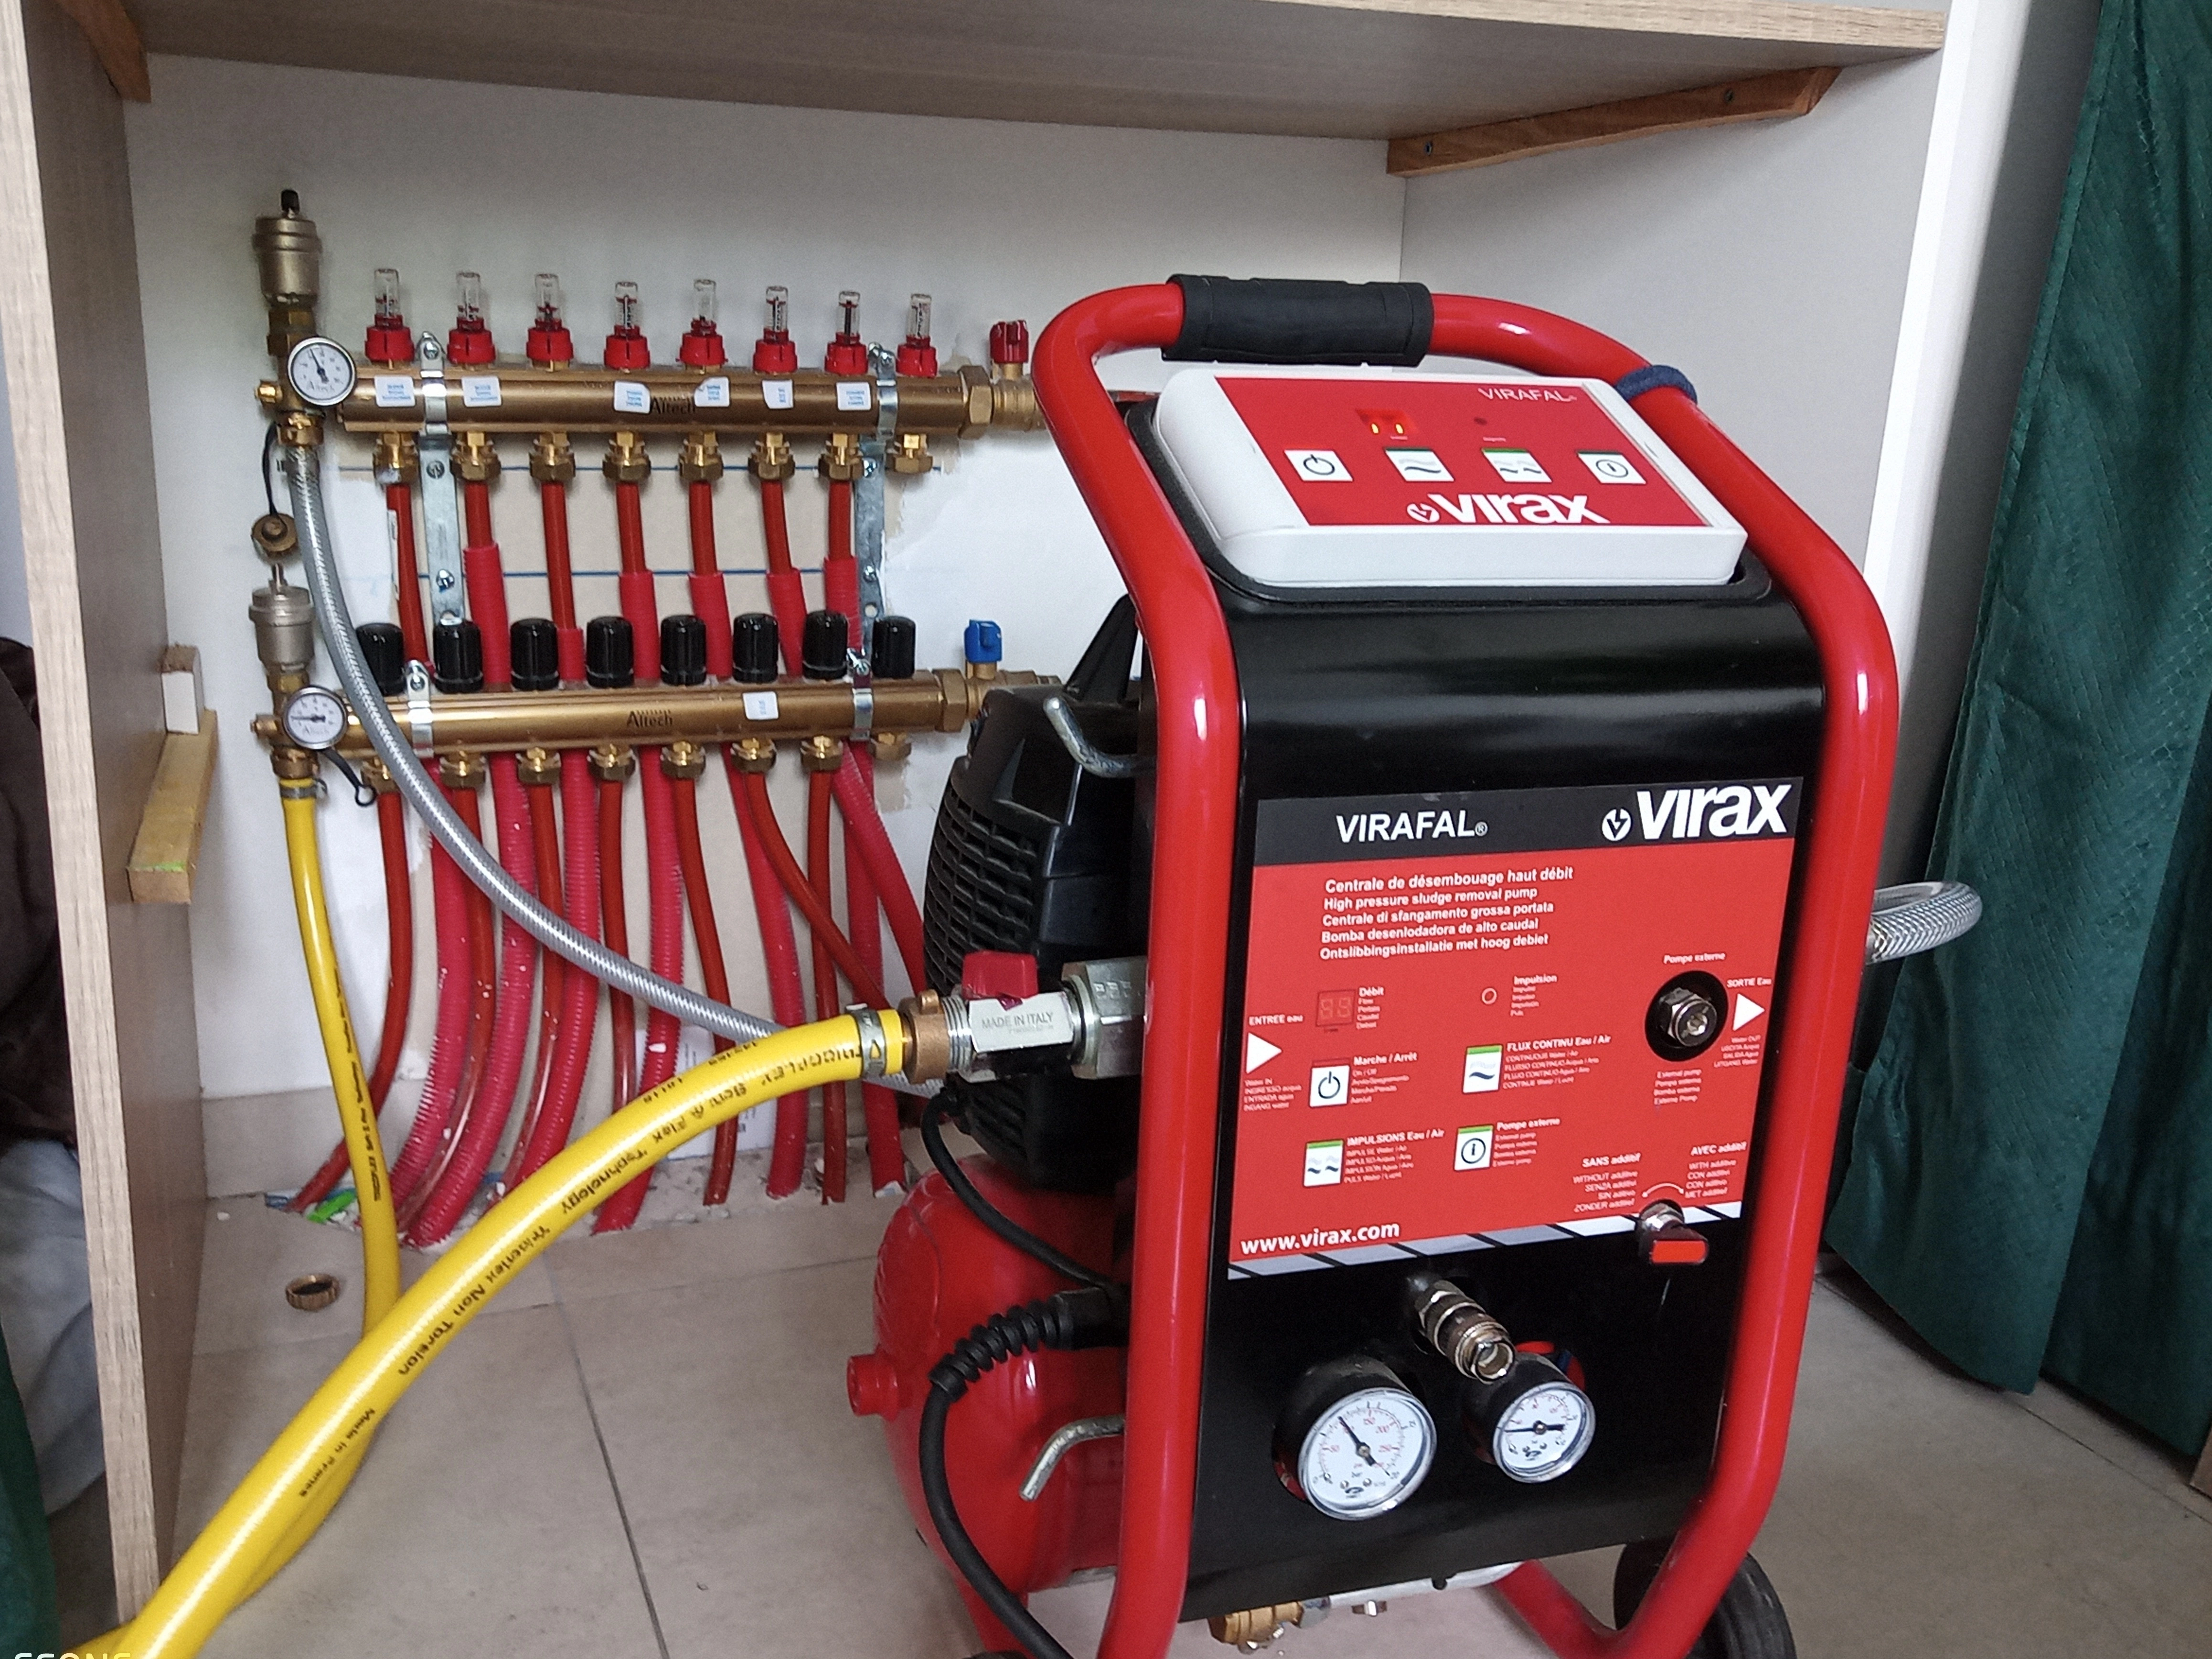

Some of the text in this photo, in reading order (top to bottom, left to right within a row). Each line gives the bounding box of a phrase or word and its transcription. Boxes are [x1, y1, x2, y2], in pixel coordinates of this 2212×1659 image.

[1427, 493, 1611, 524] virax
[1637, 784, 1792, 841] virax
[1325, 866, 1573, 893] Centrale de désembouage haut débit
[1324, 888, 1538, 912] High pressure sludge removal pump
[1322, 901, 1554, 927] Centrale di sfangamento grossa portata
[1321, 929, 1365, 943] Bomba
[1458, 922, 1473, 934] de
[1475, 920, 1498, 932] alto
[1500, 917, 1539, 931] caudal
[1320, 933, 1549, 960] Ontslibbingsinstallatie met hoog debiet
[982, 1012, 1053, 1028] MADE IN ITALY
[1582, 1156, 1609, 1167] SANS
[1690, 1144, 1717, 1156] AVEC
[1240, 1223, 1400, 1255] www.virax.com
